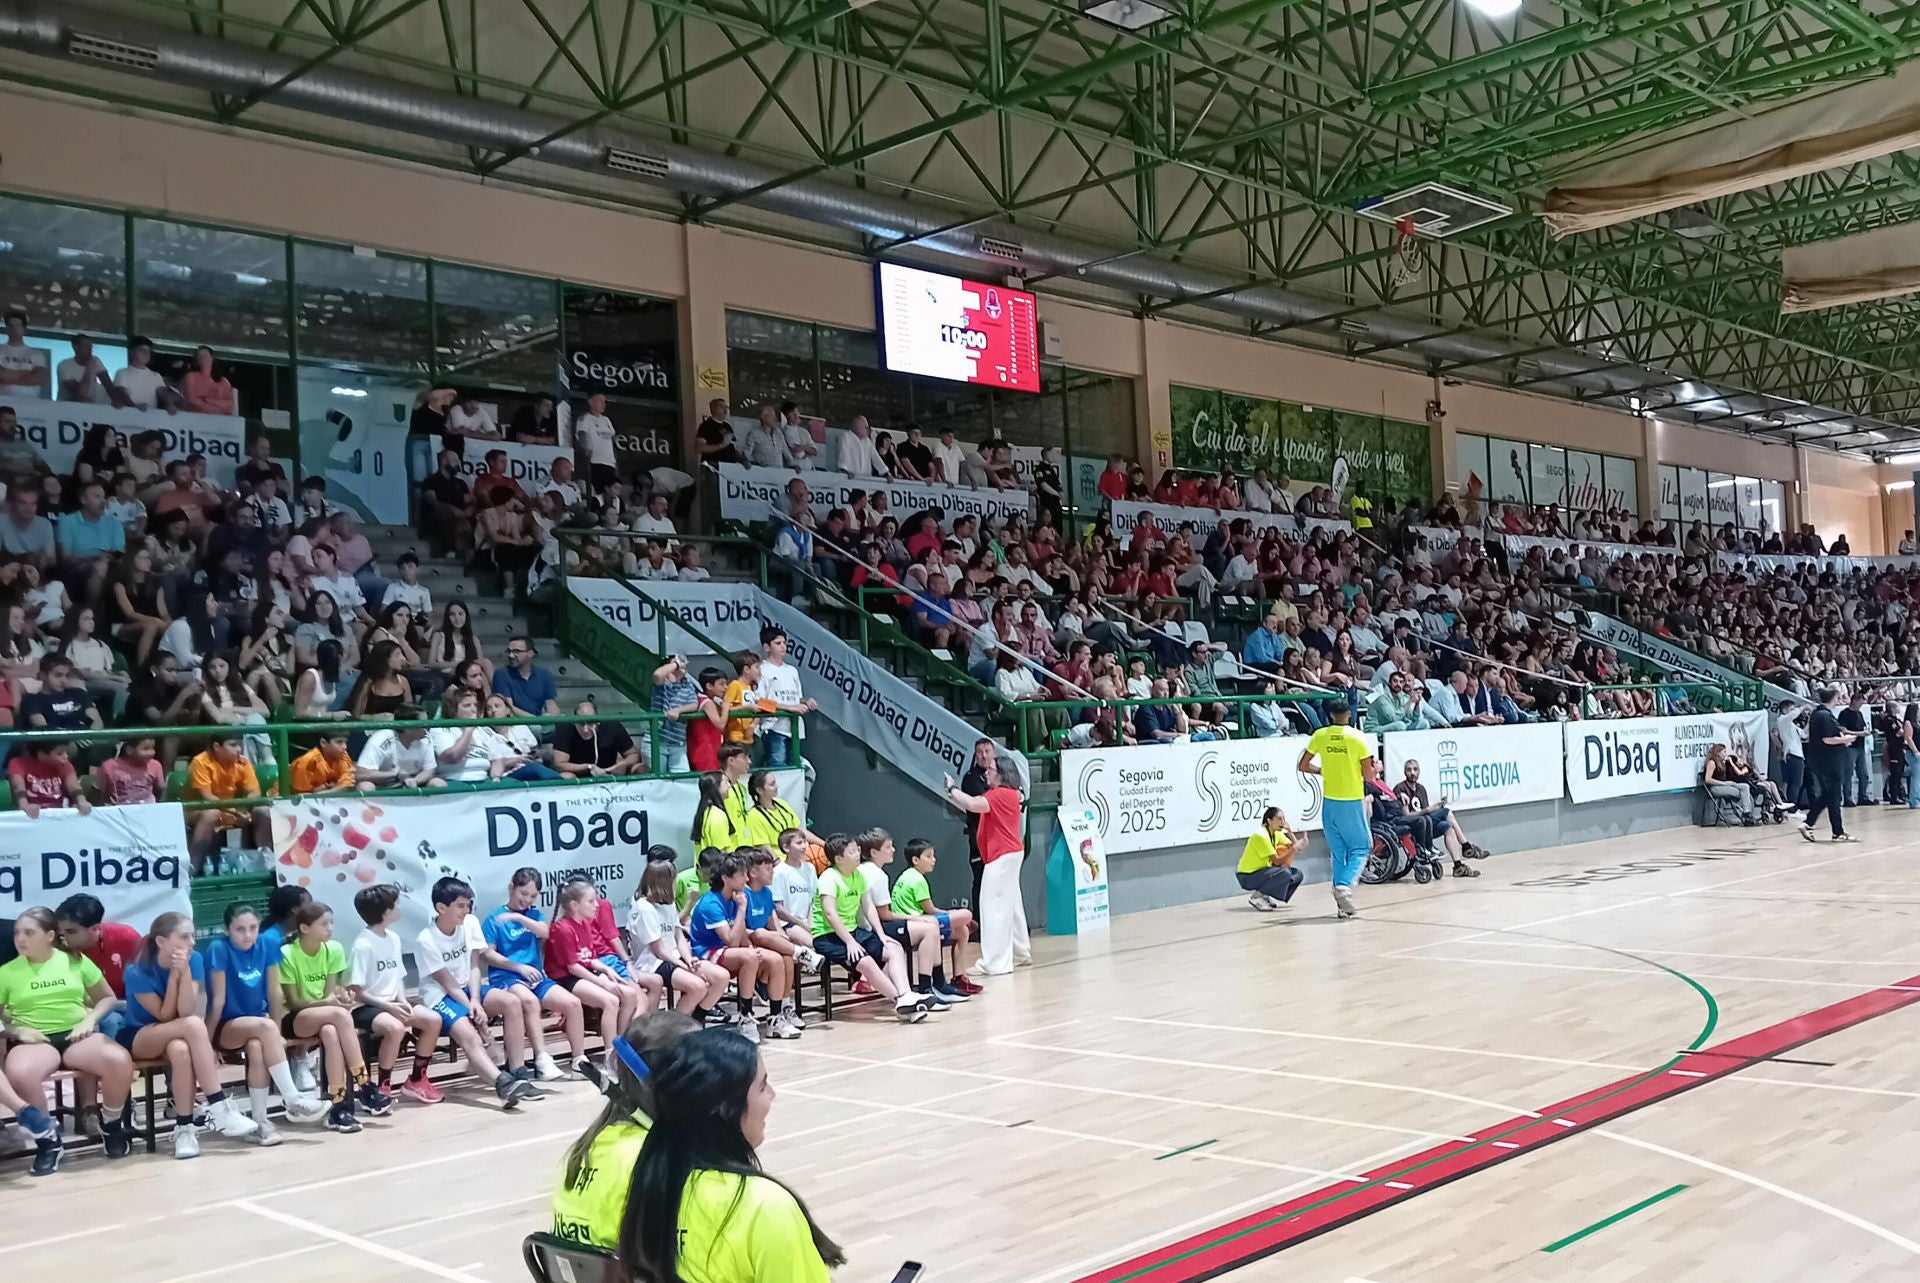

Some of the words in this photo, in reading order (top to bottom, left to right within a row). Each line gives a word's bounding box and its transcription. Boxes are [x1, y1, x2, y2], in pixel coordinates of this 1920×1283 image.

[942, 325, 987, 349] 10:00
[573, 351, 669, 388] Segovia
[615, 430, 671, 455] eada
[1192, 410, 1246, 452] Cuida
[1252, 421, 1269, 457] el
[1274, 437, 1325, 470] espacio
[1375, 452, 1405, 475] vives
[511, 459, 549, 482] Dib
[1156, 517, 1181, 533] Diba
[1192, 520, 1217, 536] Diba
[808, 645, 856, 700] Dibaq
[858, 680, 909, 738] Dibaq
[911, 717, 966, 775] Dibaq
[1674, 722, 1714, 740] ALIMENTACIÓN
[1585, 731, 1661, 782] Dibaq
[1675, 744, 1683, 759] DE
[1119, 767, 1164, 786] Segovia
[1230, 760, 1270, 777] Segovia
[1463, 761, 1520, 790] SEGOVIA
[1119, 785, 1143, 796] Ciudad
[1145, 784, 1173, 796] Europea
[1230, 790, 1241, 800] del
[1242, 787, 1271, 801] Deporte
[1120, 800, 1131, 810] del
[1133, 797, 1165, 811] Deporte
[485, 801, 649, 857] Dibaq
[1120, 808, 1166, 834] 2025
[41, 848, 180, 889] Dibaq
[31, 978, 66, 990] Dibaq
